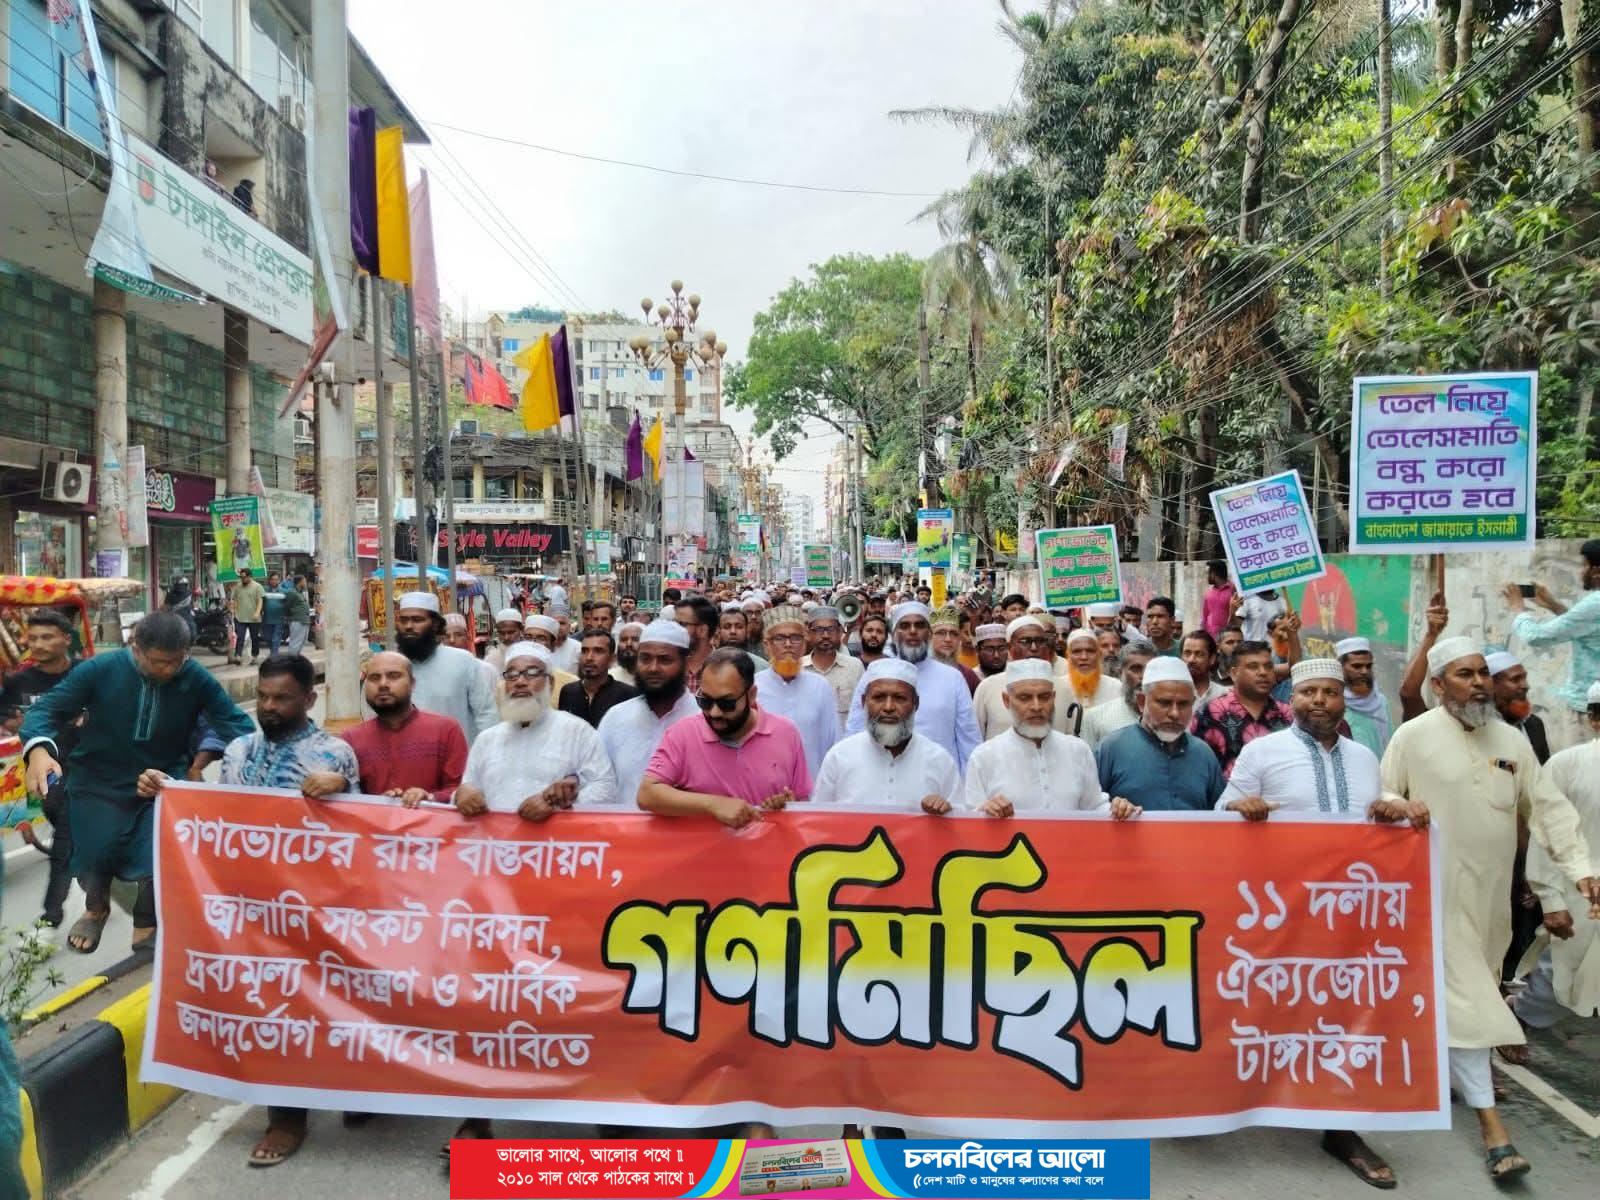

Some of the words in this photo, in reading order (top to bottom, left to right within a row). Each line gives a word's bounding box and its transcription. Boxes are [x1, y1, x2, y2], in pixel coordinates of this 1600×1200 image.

[1378, 393, 1436, 414] তেল
[1447, 385, 1508, 416] নিয়ে
[1366, 418, 1520, 449] তেলেসমাতি
[1436, 457, 1506, 482] করো
[1227, 494, 1254, 512] তেল
[1257, 484, 1287, 502] নিয়ে
[1365, 490, 1452, 514] করতে
[1462, 488, 1515, 508] হবে
[1228, 501, 1299, 533] তেলেসমাতি
[1365, 521, 1418, 538] বাংলাদেশ
[1422, 520, 1473, 538] জামায়াতে
[1477, 516, 1517, 535] ইসলামী
[438, 529, 487, 552] Syle
[492, 528, 552, 552] Valley
[1238, 549, 1280, 570] করতে
[174, 815, 361, 869] গণভোটের
[372, 834, 444, 873] রায়
[455, 837, 623, 886] বাস্তবায়ন,
[1236, 880, 1287, 931] ১১
[1302, 862, 1412, 931] দলীয়
[203, 889, 313, 939] জ্বালানি
[322, 898, 430, 949] সংকট
[440, 901, 562, 960] নিরসন,
[602, 825, 1205, 1090] গণমিছিল
[185, 949, 309, 1008] দ্রব্যমূল্য
[318, 949, 420, 1007] নিয়ন্ত্রণ
[431, 974, 459, 1008] ও
[472, 958, 582, 1015] সার্বিক
[176, 1002, 320, 1061] জনদুর্ভোগ
[327, 1019, 460, 1064] লাঘবের
[467, 1019, 594, 1069] দাবিতে
